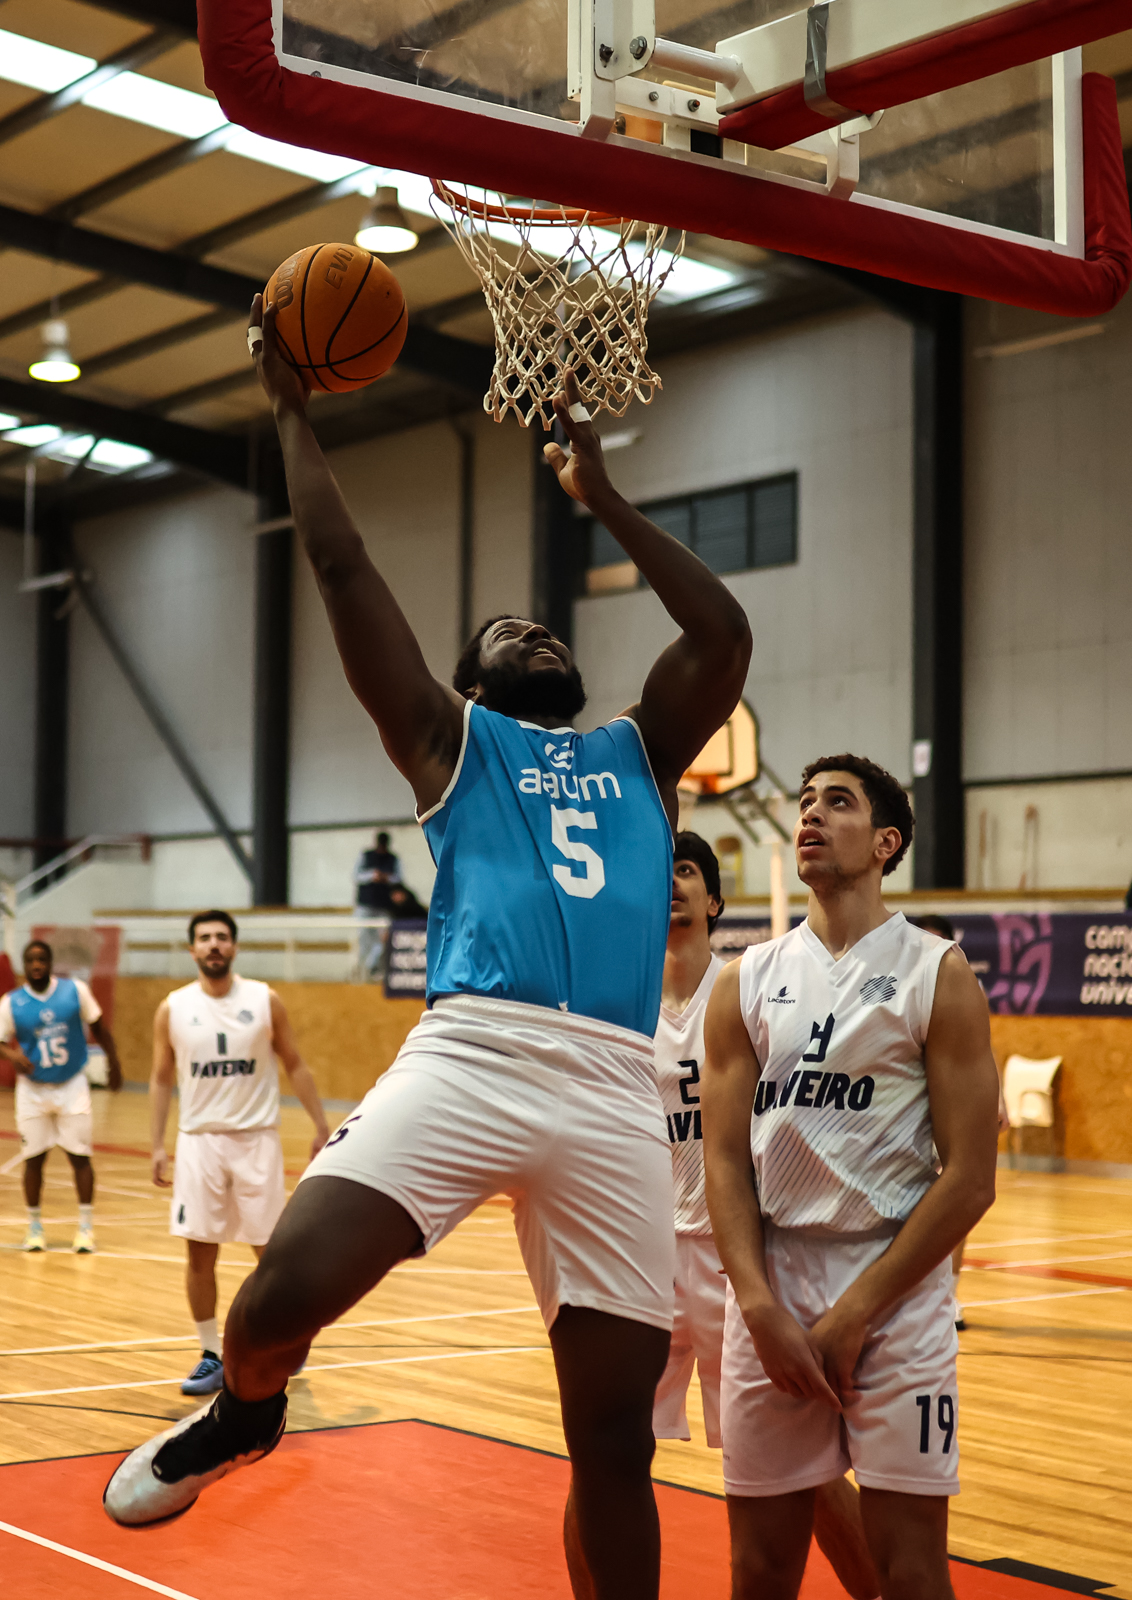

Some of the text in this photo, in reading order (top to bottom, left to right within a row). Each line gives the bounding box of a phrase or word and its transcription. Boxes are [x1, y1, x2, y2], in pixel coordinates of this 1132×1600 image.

[550, 804, 606, 899] 5
[38, 1035, 70, 1068] 15
[677, 1059, 700, 1105] 2
[916, 1394, 954, 1455] 19
